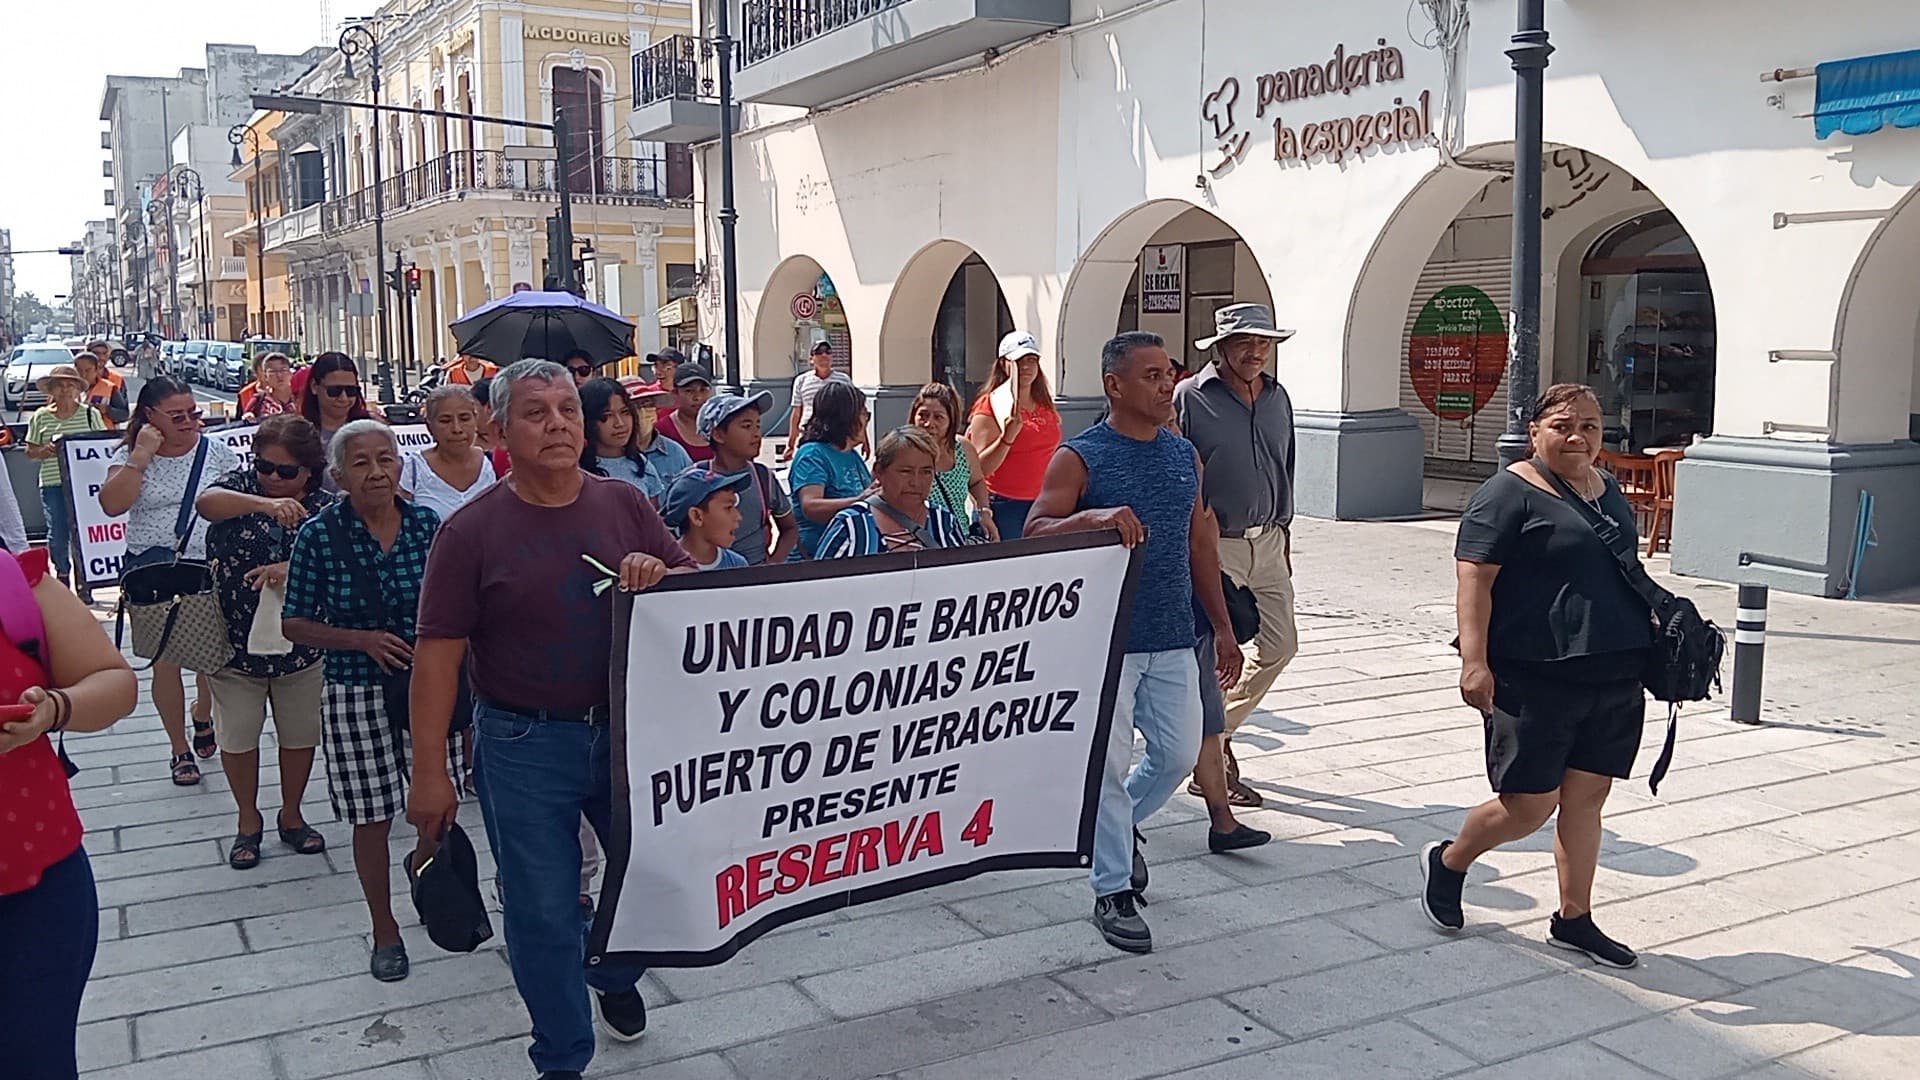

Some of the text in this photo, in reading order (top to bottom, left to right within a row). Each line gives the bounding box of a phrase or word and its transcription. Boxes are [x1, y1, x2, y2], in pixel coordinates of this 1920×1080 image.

[523, 25, 631, 47] McDonald's
[1256, 38, 1404, 118] panaderia
[1273, 90, 1431, 163] la especial
[1145, 273, 1180, 290] SE RENTA
[76, 447, 101, 460] LA
[682, 578, 1084, 675] UNIDAD DE BARRIOS
[718, 640, 1035, 733] Y COLONIAS DEL
[651, 690, 1080, 827] PUERTO DE VERACRUZ
[762, 763, 960, 839] PRESENTE
[715, 799, 994, 930] RESERVA 4
